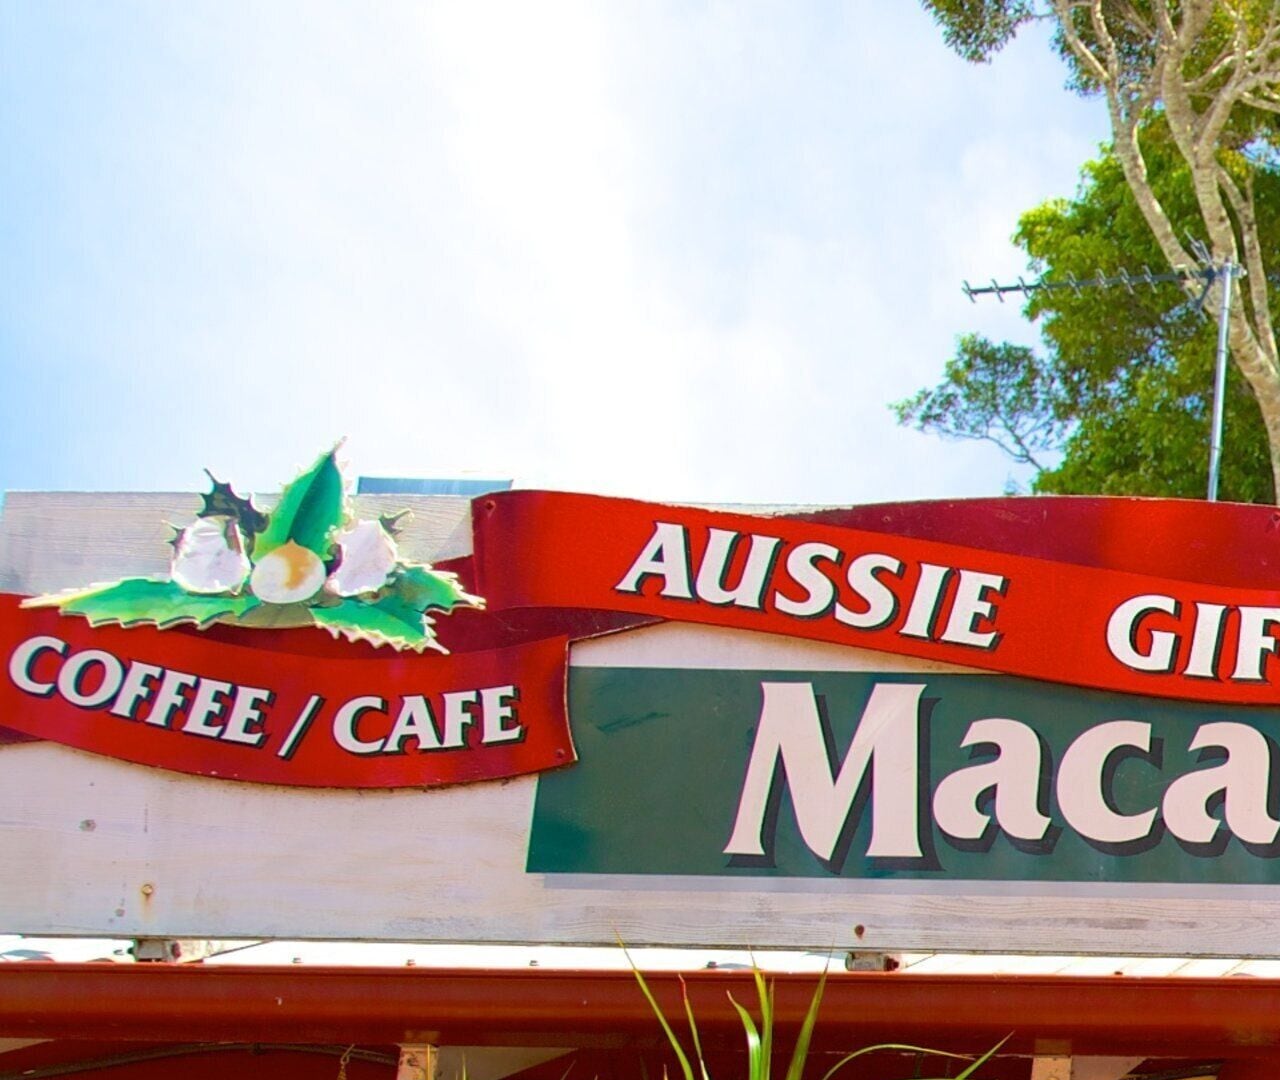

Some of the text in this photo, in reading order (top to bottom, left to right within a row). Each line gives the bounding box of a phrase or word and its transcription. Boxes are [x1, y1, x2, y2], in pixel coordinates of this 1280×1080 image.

[615, 521, 1007, 650] AUSSIE
[8, 636, 271, 746] COFFEE
[333, 685, 523, 754] CAFE
